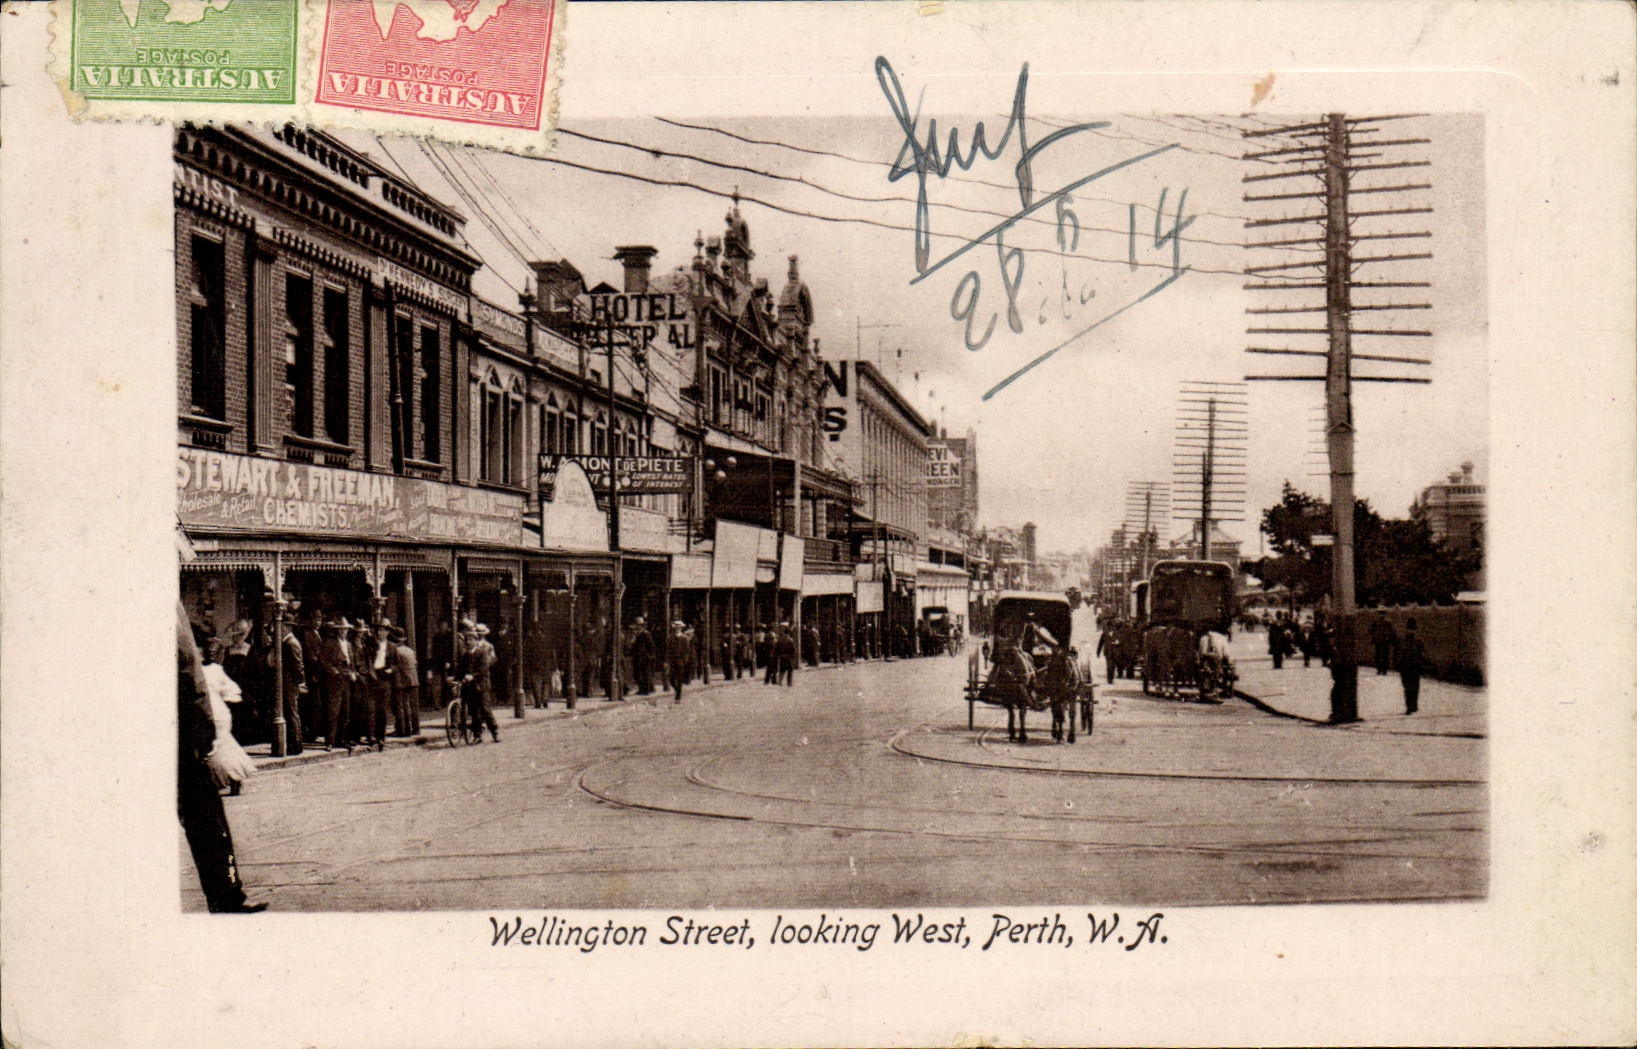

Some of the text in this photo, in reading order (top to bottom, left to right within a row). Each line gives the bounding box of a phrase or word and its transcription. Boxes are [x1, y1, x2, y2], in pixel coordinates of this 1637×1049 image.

[136, 48, 231, 65] POSTAGE
[80, 64, 285, 90] AUSTRALIA
[386, 61, 480, 86] POSTAGE
[328, 71, 534, 116] AUSTRALIA
[590, 293, 687, 322] HOTEL
[637, 457, 684, 472] PIETE
[175, 450, 394, 507] STEWART & FREEMAN
